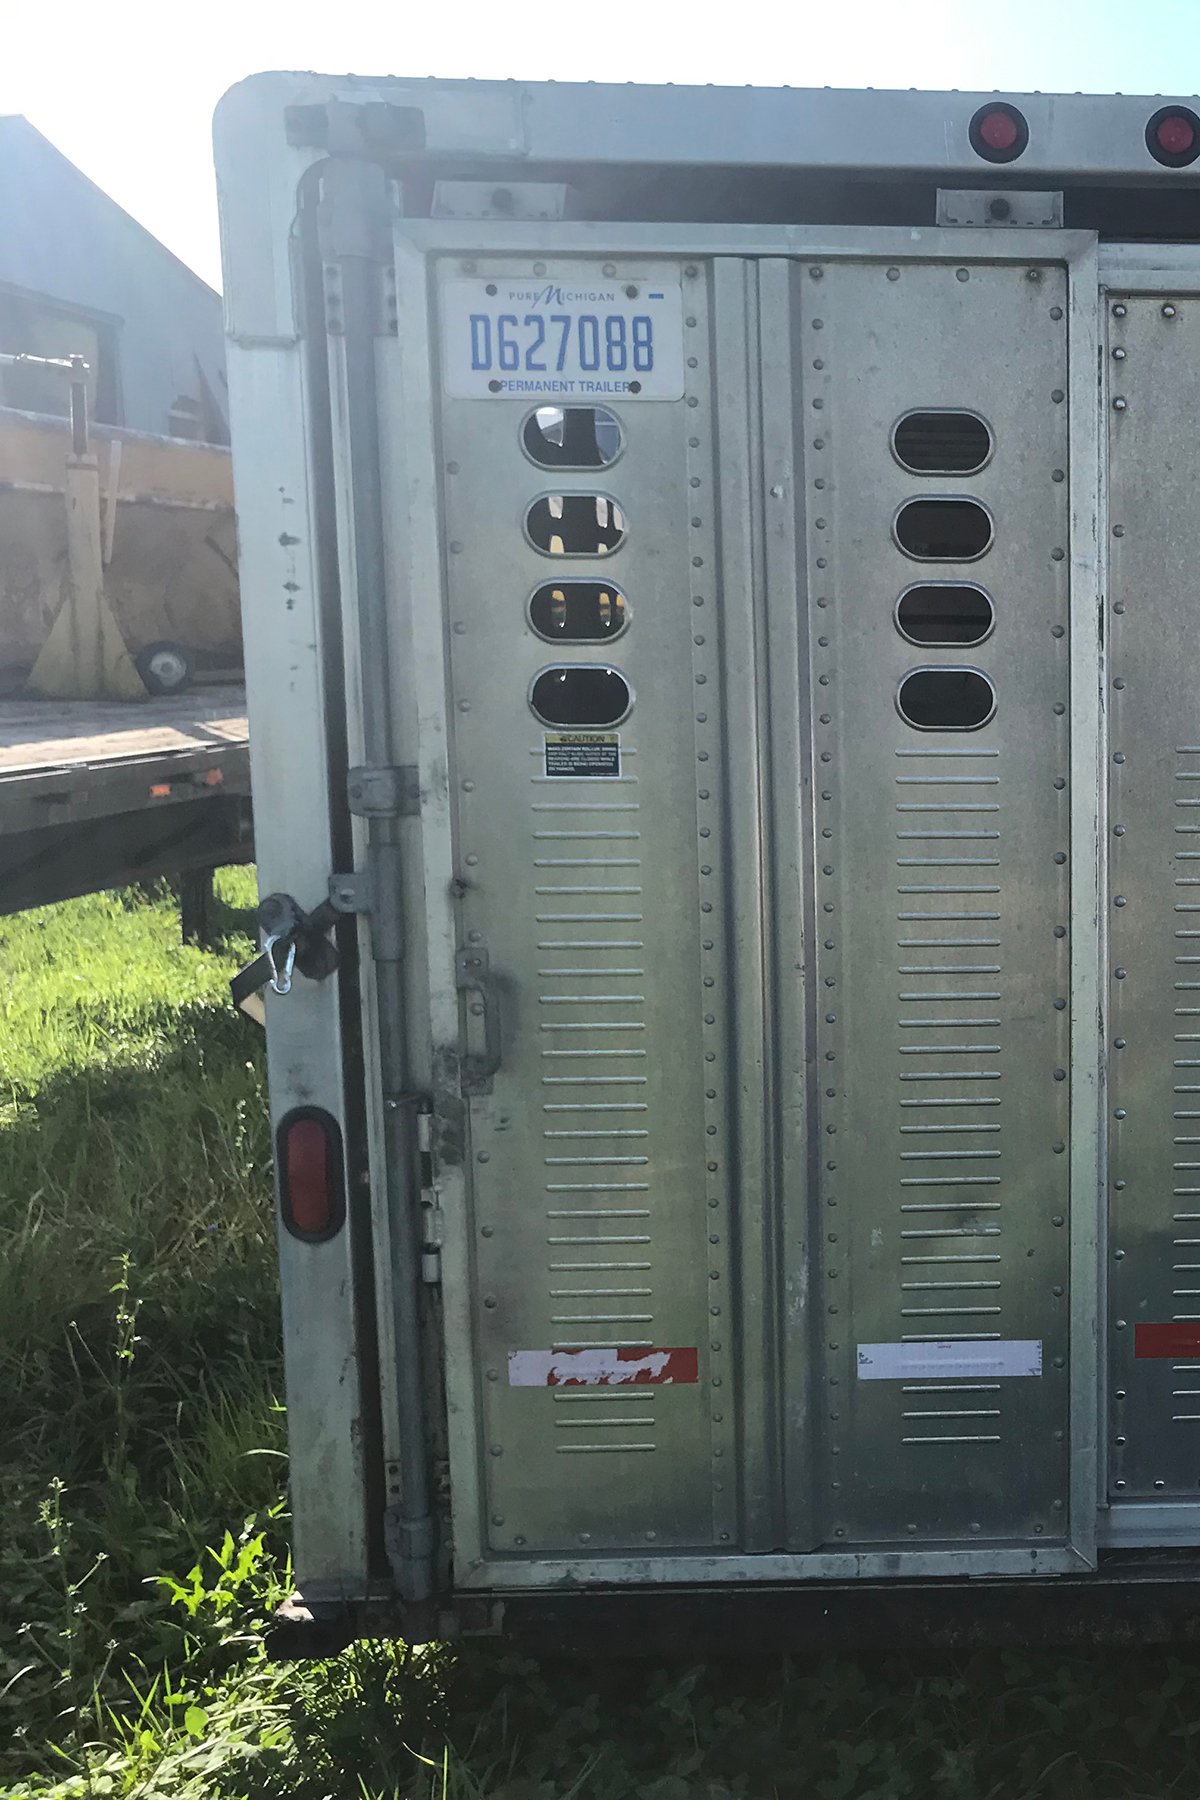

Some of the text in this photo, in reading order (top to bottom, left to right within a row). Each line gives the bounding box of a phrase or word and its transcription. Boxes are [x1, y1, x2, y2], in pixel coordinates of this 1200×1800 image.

[508, 285, 615, 309] PURE MICHIGAN
[469, 314, 653, 371] D627088
[500, 380, 631, 393] PERMANENT TRAILER
[567, 734, 606, 742] CAUTION
